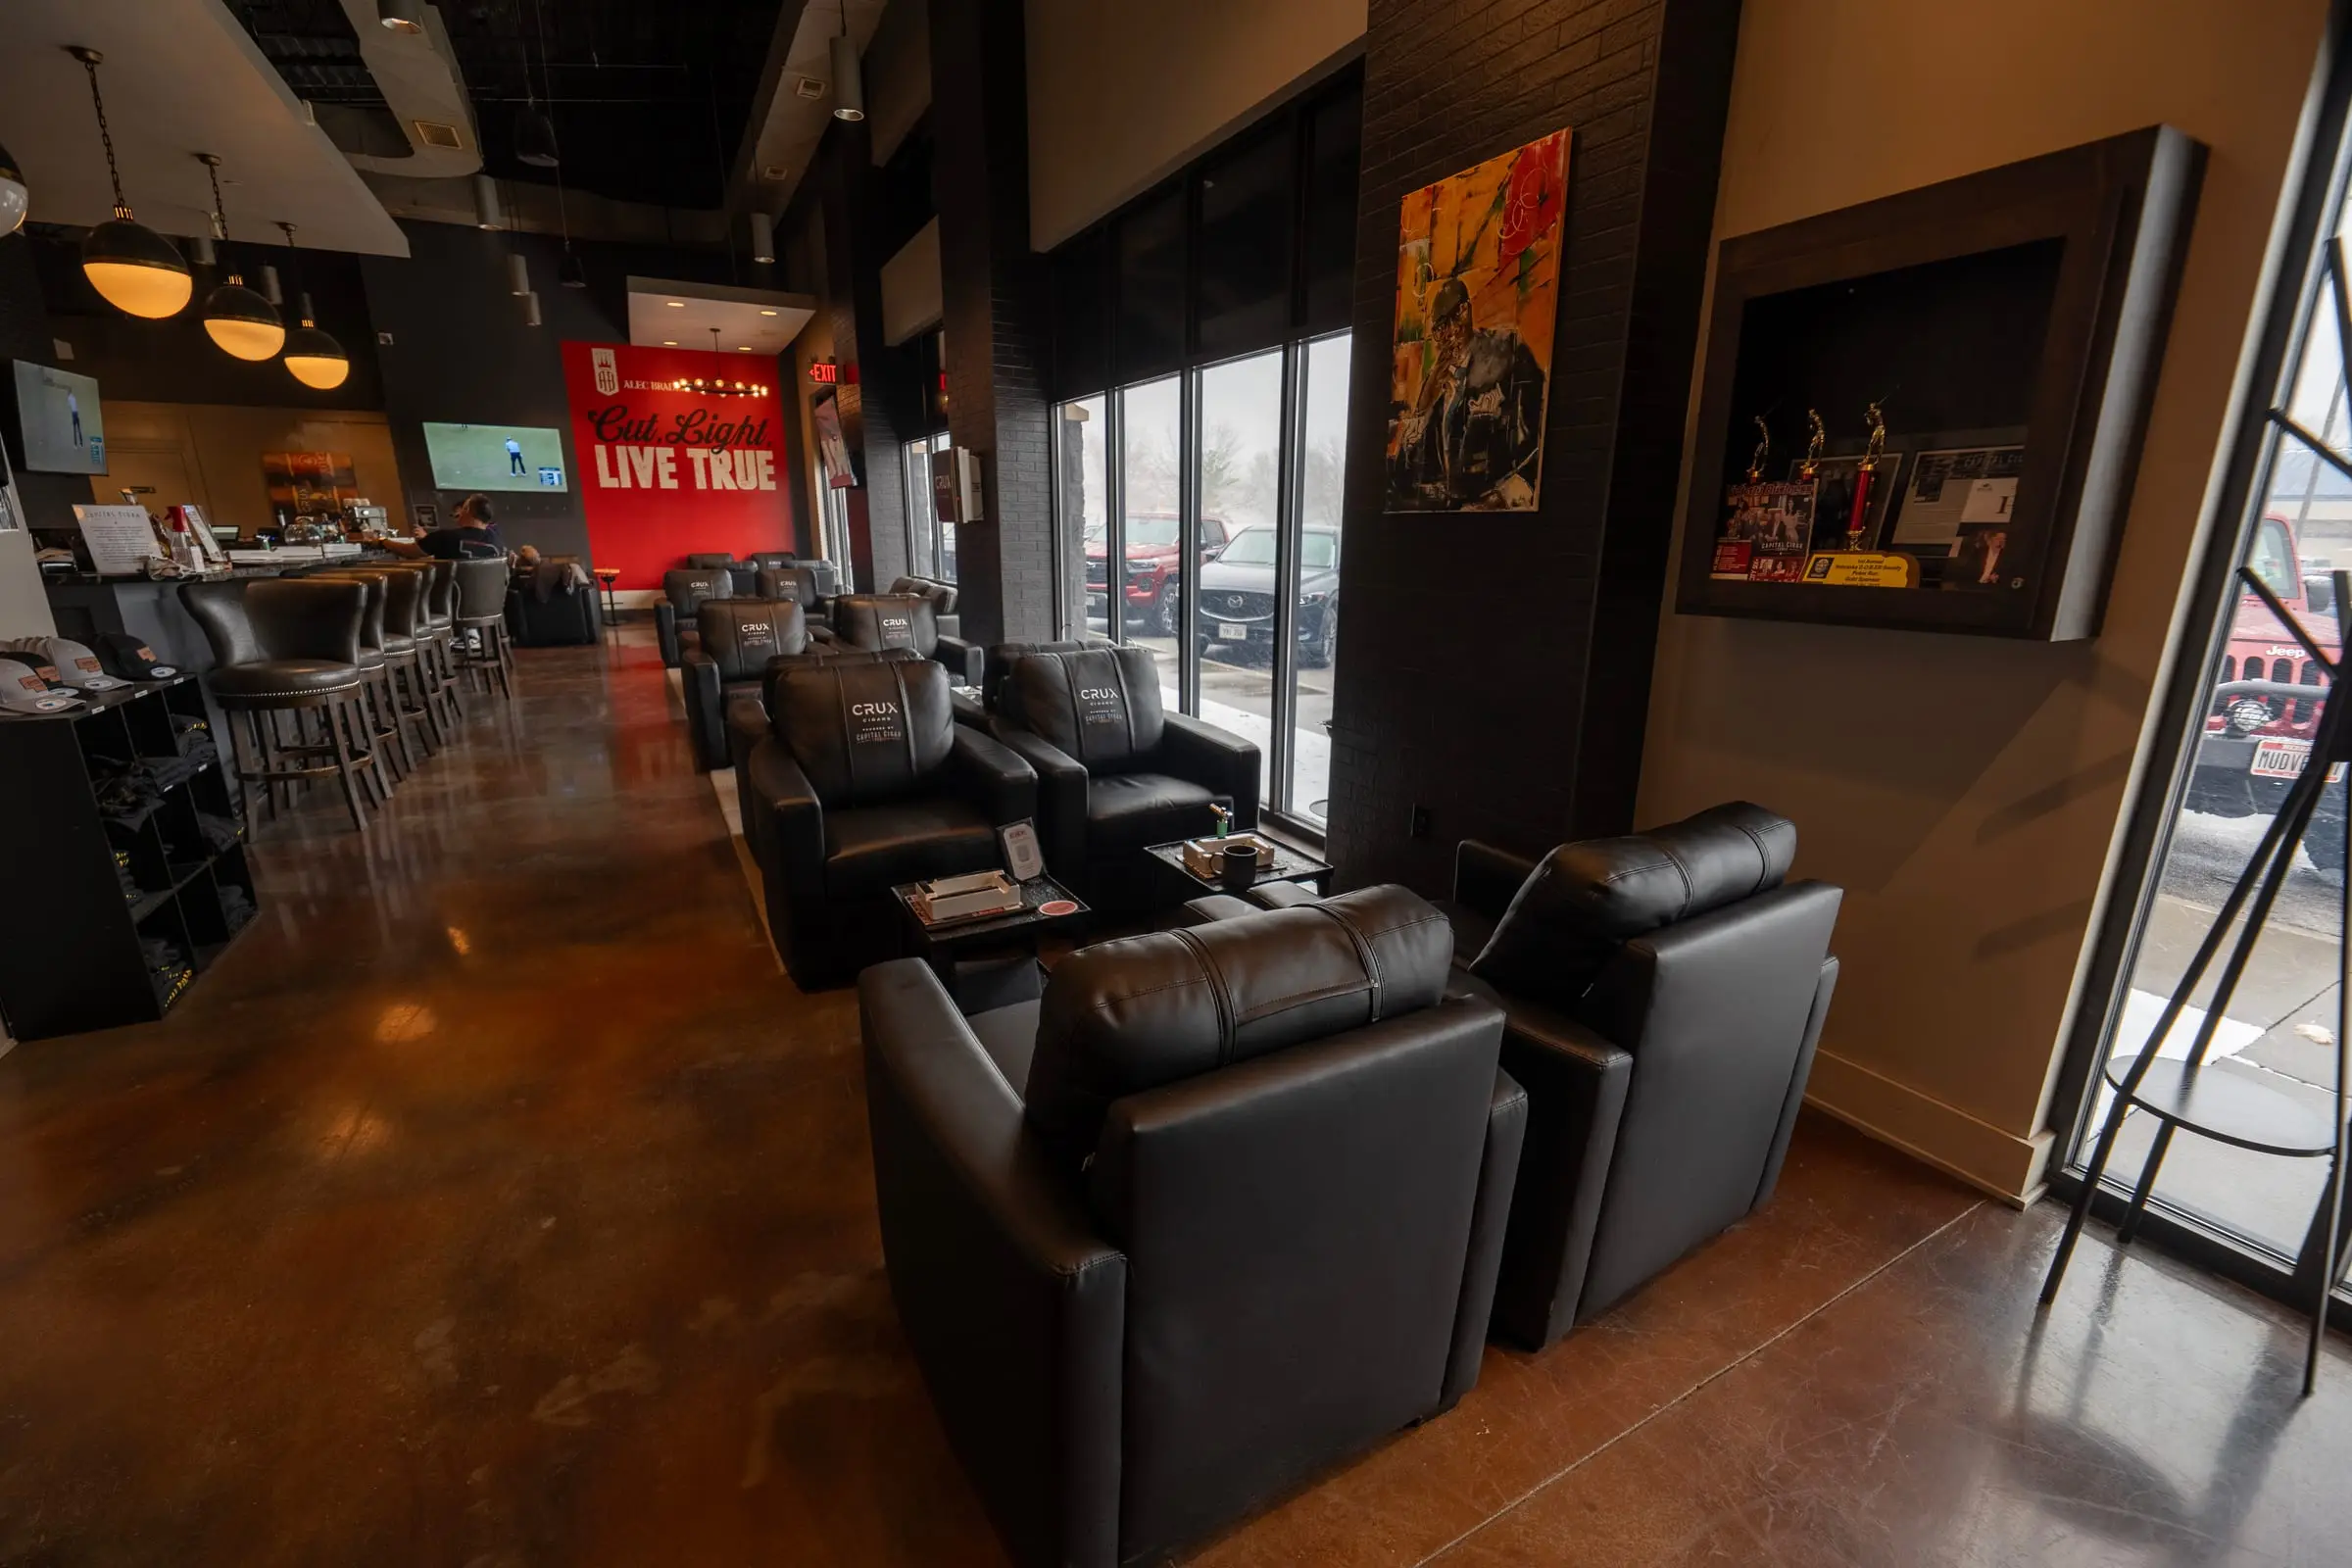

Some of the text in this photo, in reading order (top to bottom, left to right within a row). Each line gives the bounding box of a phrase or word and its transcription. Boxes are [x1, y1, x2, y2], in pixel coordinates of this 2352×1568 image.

[813, 364, 837, 383] EXIT
[623, 379, 650, 390] ALEC
[594, 444, 679, 489] LIVE
[686, 447, 777, 491] TRUE
[741, 622, 770, 633] CRUX
[883, 618, 907, 627] CRUX
[2266, 645, 2306, 660] Jeep
[1080, 687, 1119, 700] CRUX
[852, 701, 899, 716] CRUX
